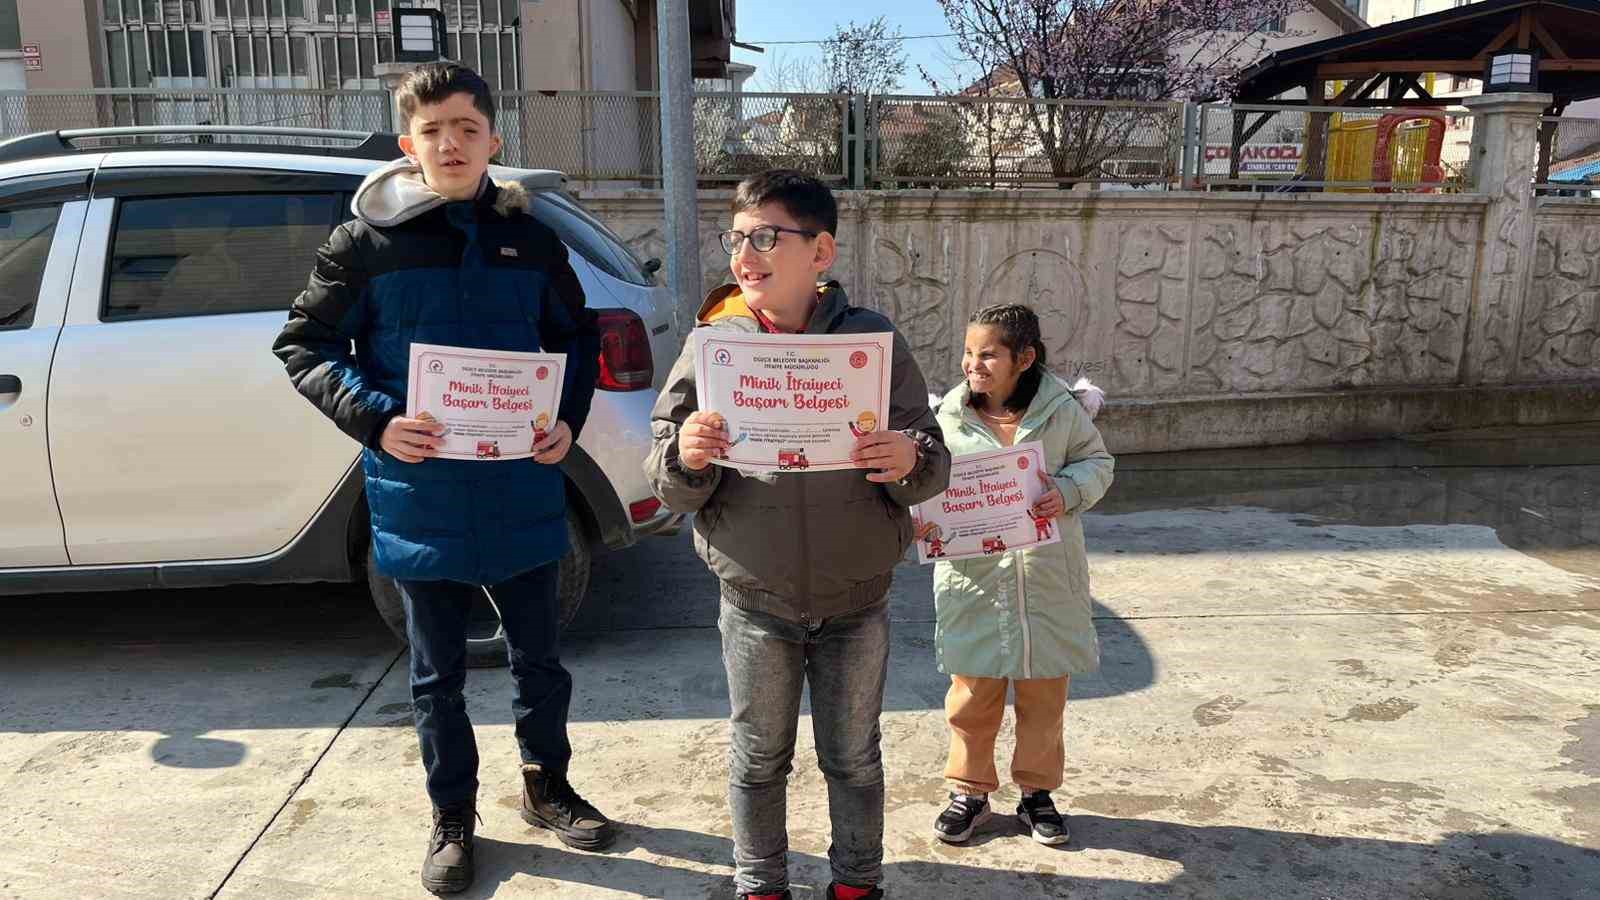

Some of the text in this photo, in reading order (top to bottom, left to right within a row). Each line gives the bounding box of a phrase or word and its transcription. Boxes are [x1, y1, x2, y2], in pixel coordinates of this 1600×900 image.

[1205, 145, 1303, 162] ÇOAKOĞL
[449, 379, 529, 399] Minik İtfaiyeci
[740, 371, 844, 394] Minik İtfaiyeci
[442, 393, 533, 413] Başarı Belgesi
[732, 391, 849, 413] Başarı Belgesi
[944, 478, 1018, 499] Minik İtfaiyeci
[942, 489, 1024, 514] Başarı Belgesi
